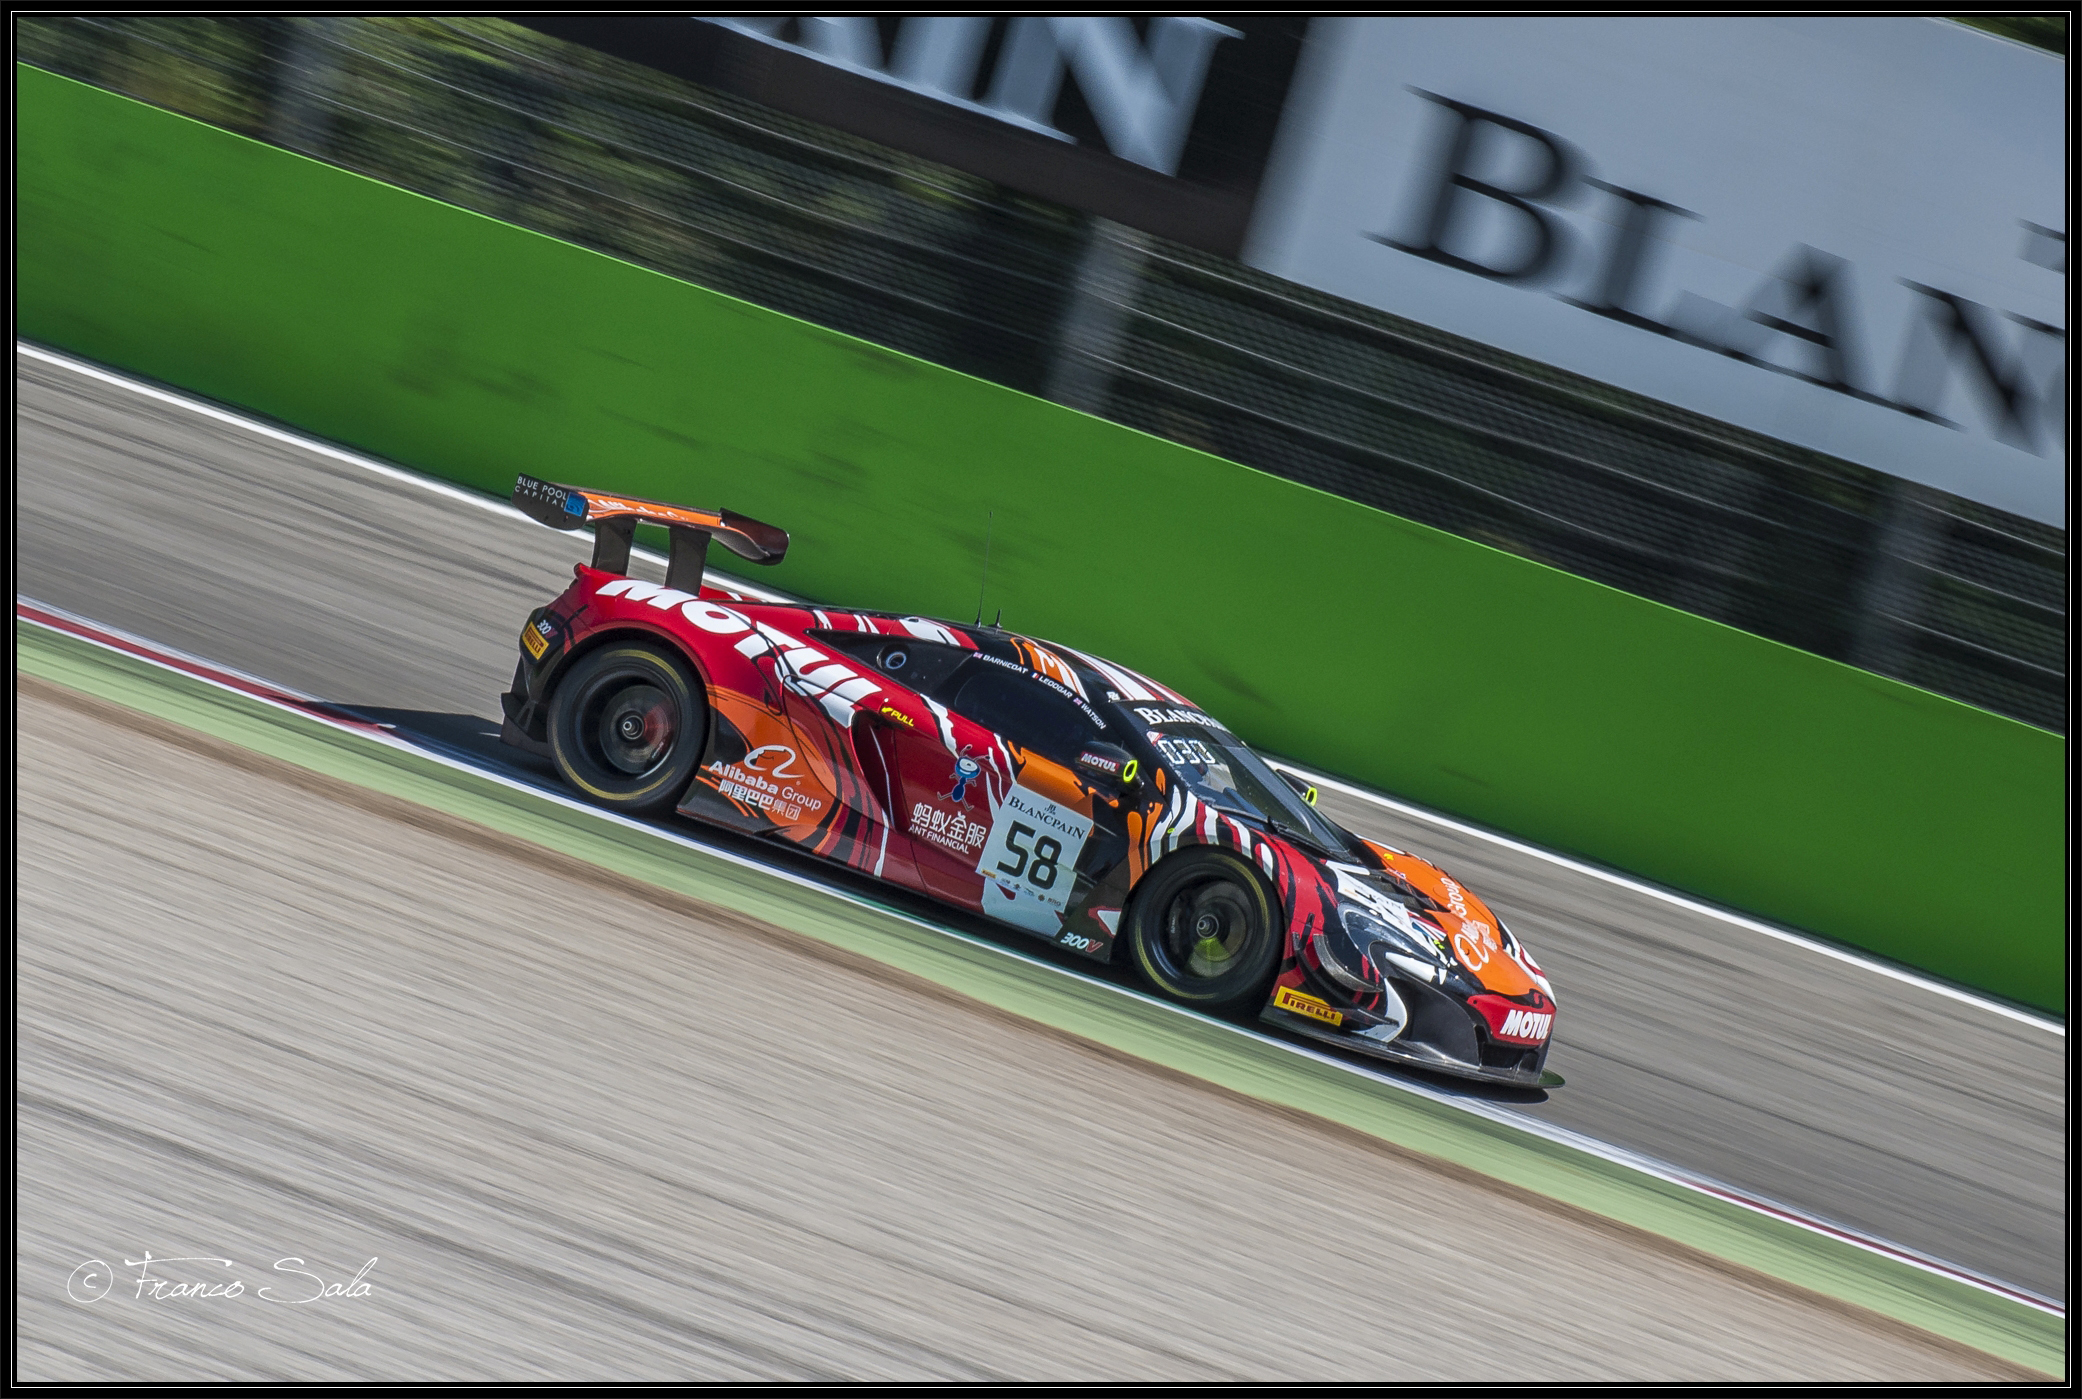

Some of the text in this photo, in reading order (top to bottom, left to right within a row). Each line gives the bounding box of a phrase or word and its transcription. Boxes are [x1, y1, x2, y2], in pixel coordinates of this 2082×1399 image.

[1360, 83, 2065, 458] BLAN
[514, 485, 566, 509] CAPITAL
[517, 476, 567, 501] BLUE POOL
[595, 579, 882, 728] MOTUL
[982, 654, 1106, 729] BARNICOAT LEDOGAR WATSON
[890, 709, 915, 727] PULL
[1081, 753, 1117, 772] MOTUL
[708, 760, 822, 810] Alibaba Group
[718, 778, 801, 821] 阿里巴巴集团
[911, 802, 987, 849] 蚂蚁金服
[1008, 795, 1086, 840] BLANCPAIN
[908, 823, 970, 855] ANT FINANCIAL
[996, 819, 1062, 890] 58
[1060, 931, 1104, 953] 300V
[1282, 992, 1337, 1020] PIRELLI
[1499, 1009, 1552, 1040] MOTUL
